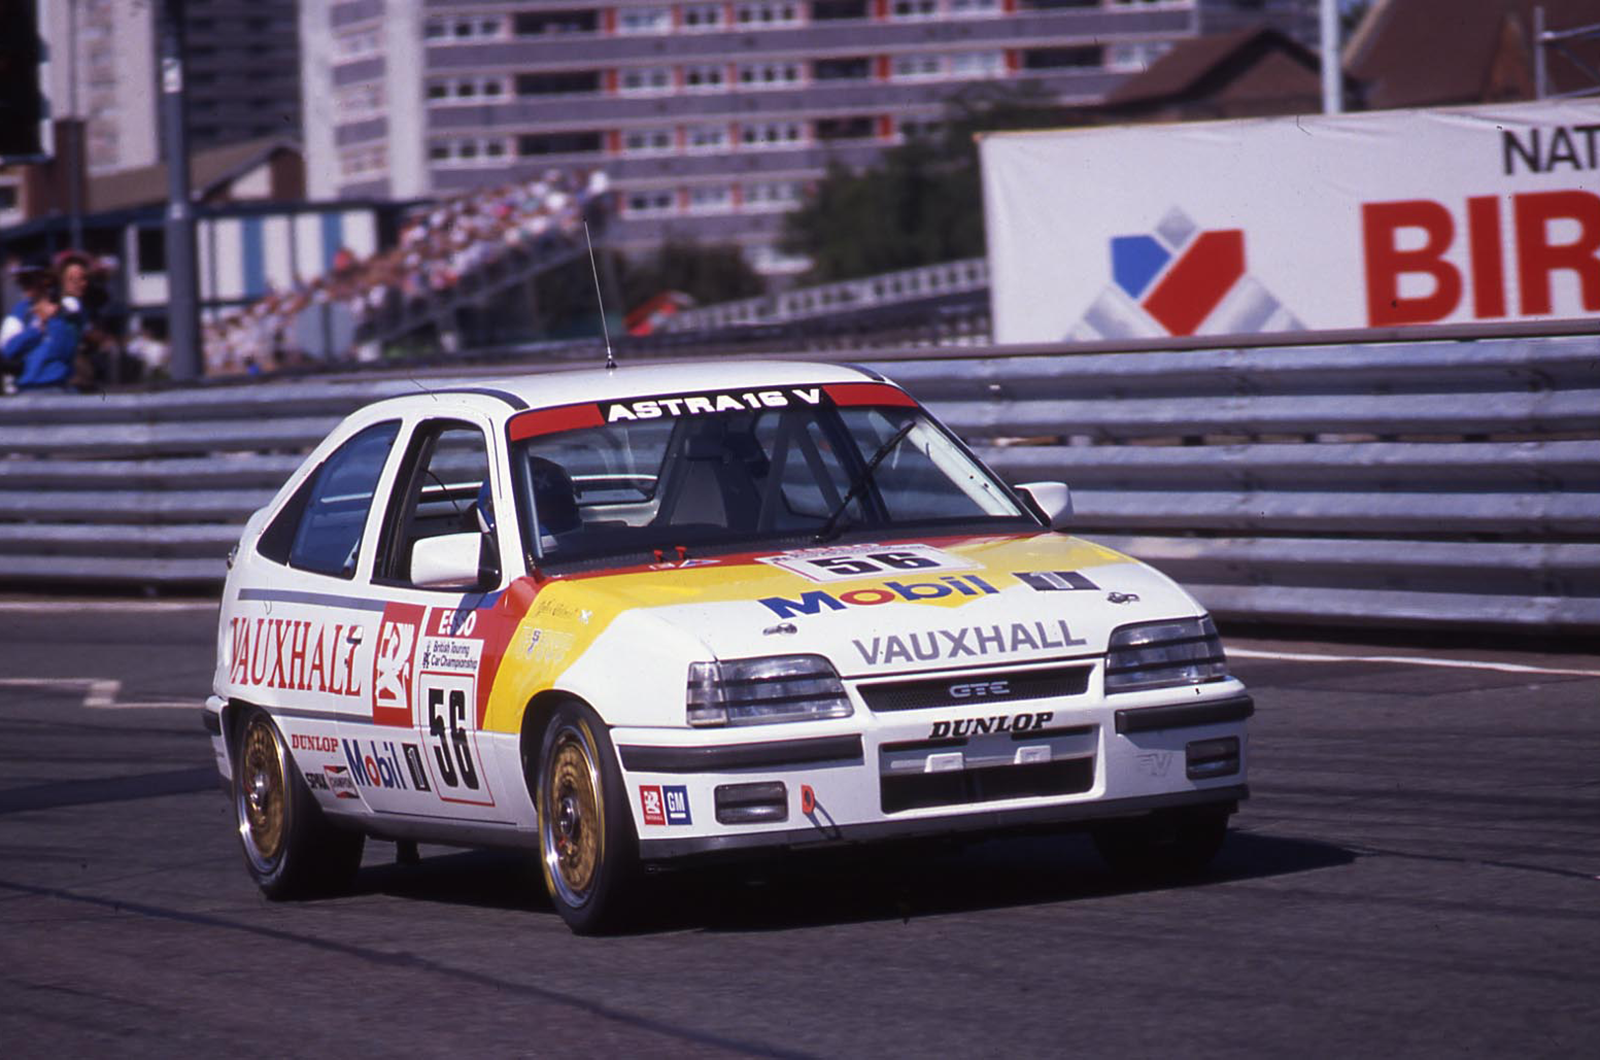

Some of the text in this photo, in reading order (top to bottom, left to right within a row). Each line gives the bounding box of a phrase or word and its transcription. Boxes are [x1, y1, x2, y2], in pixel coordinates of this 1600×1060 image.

[1502, 125, 1600, 176] NAT
[1361, 190, 1600, 328] BIR
[808, 551, 940, 575] 56
[758, 575, 1000, 620] Mobil
[231, 617, 363, 697] VAUXHALL
[852, 619, 1087, 666] VAUXHALL
[291, 734, 339, 753] DUNLOP
[428, 688, 479, 790] 56
[929, 712, 1054, 739] DUNLOP
[342, 738, 408, 790] Mobil
[667, 791, 686, 812] GM
